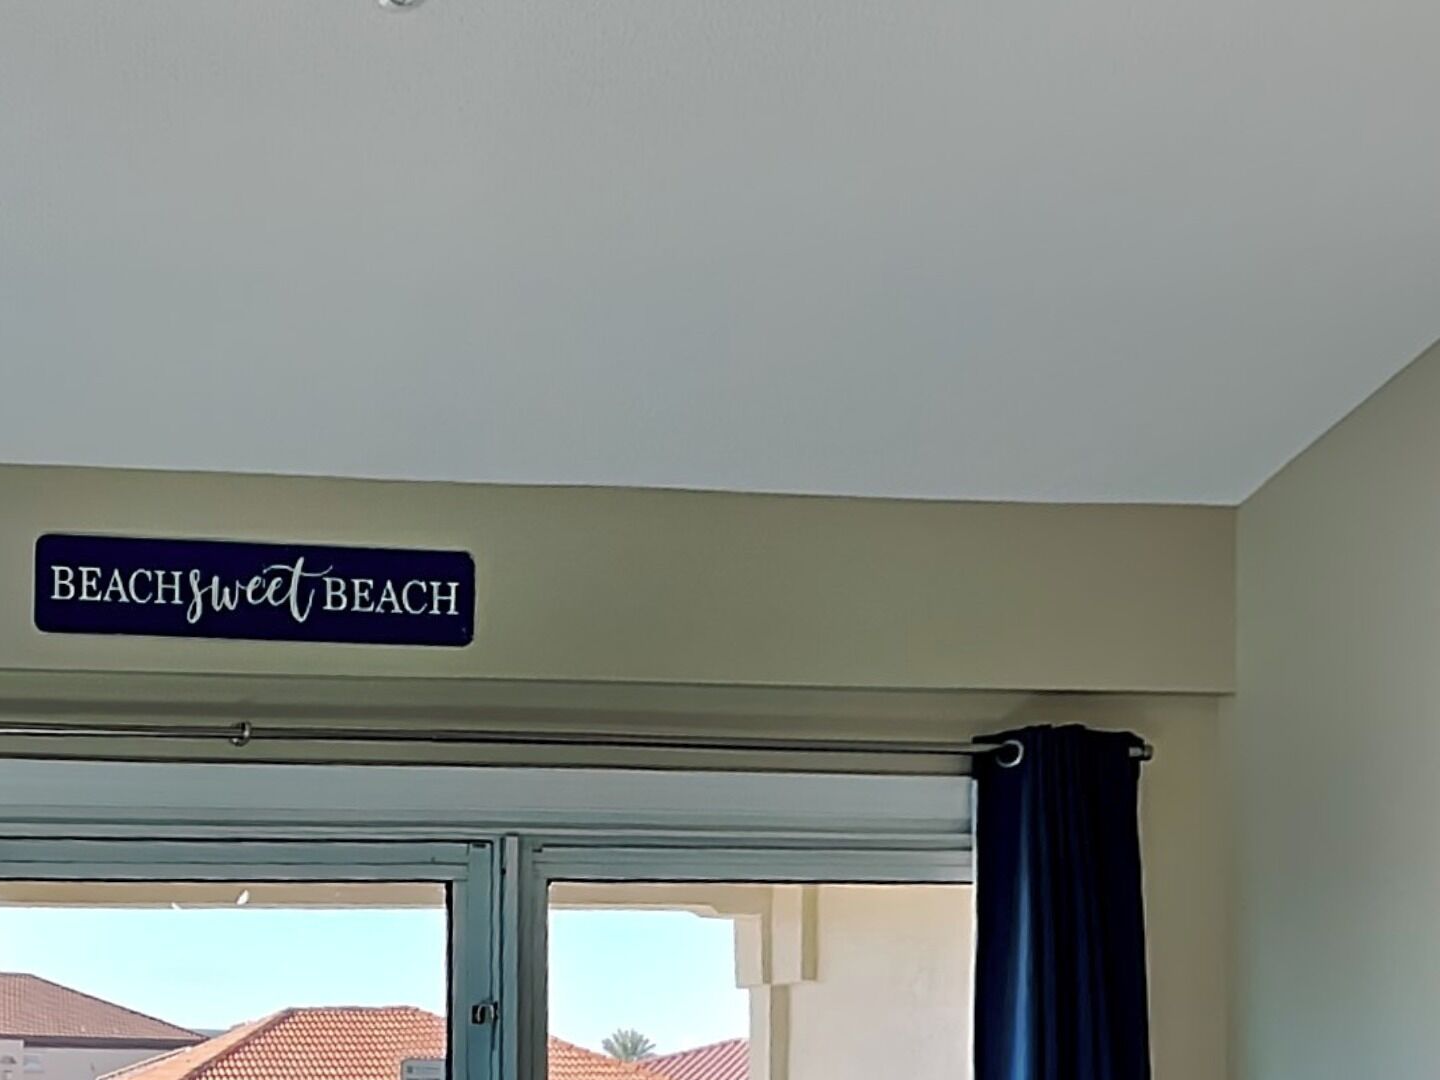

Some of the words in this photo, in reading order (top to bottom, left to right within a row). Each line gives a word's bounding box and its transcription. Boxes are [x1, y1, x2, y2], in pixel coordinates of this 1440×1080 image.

[50, 565, 183, 605] BEACH
[186, 556, 333, 624] sweet
[322, 577, 461, 616] BEACH
